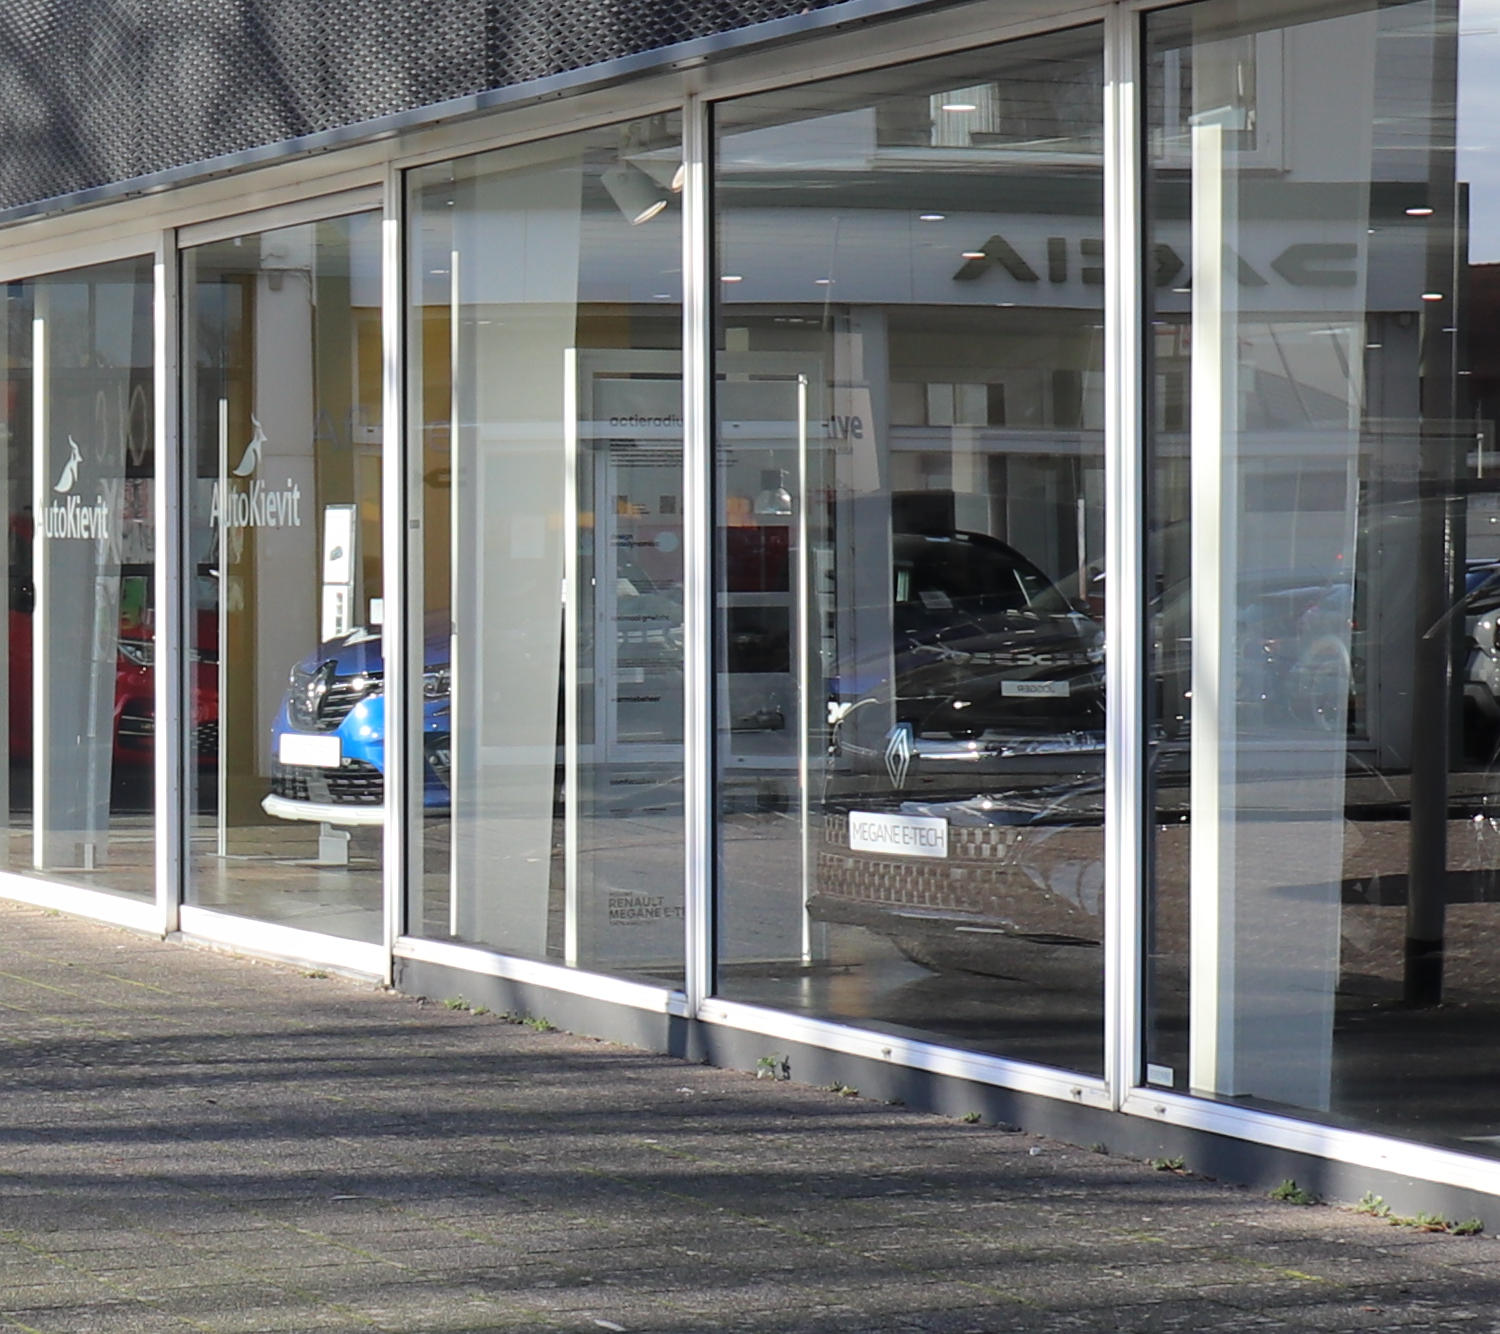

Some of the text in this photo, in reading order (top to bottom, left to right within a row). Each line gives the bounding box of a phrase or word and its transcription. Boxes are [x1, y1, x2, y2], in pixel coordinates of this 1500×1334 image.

[610, 414, 684, 428] actieradiu
[852, 822, 945, 848] MEGANE E-TECH
[609, 896, 664, 908] RENAULT
[609, 908, 661, 919] MEGANE
